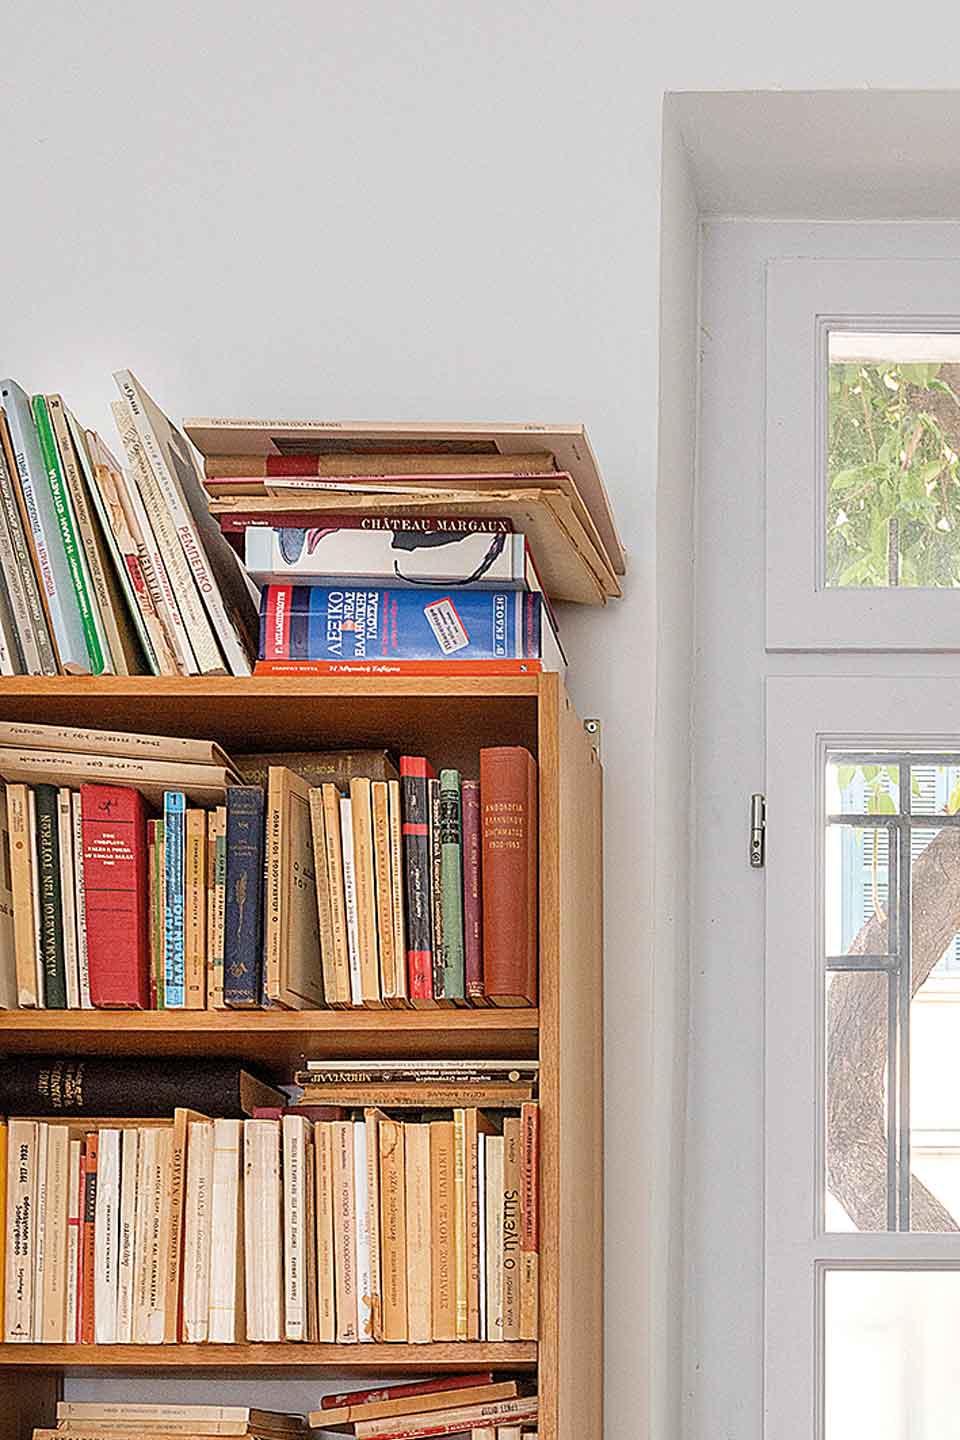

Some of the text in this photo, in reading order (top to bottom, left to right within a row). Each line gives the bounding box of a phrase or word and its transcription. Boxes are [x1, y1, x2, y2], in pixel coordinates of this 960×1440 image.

[361, 515, 507, 534] CHÂTEAU MARGAUX
[176, 523, 213, 594] ΡΕΜΠΕΤΙΚΟ
[326, 591, 343, 655] ΛΕΞΙΚΟ
[344, 591, 355, 618] ΝΕΑΣ
[353, 591, 369, 657] ΕΛΛΗΝΙΚΗΣ
[366, 591, 380, 640] ΓΛΩΣΣΑΣ
[495, 596, 506, 640] ΕΚΔΟΣΗ
[38, 814, 58, 976] ΑΙΧΜΑΛΩΤΟΙ ΤΩΝ ΤΟΥΡΚΩΝ
[171, 1147, 182, 1194] ΝΑΥΑΓΟΣ
[171, 1197, 179, 1205] Ο
[438, 1147, 448, 1309] ΣΤΡΑΤΩΝΟΣ ΜΟΥΣΑ ΠΑΙΔΙΚΗ
